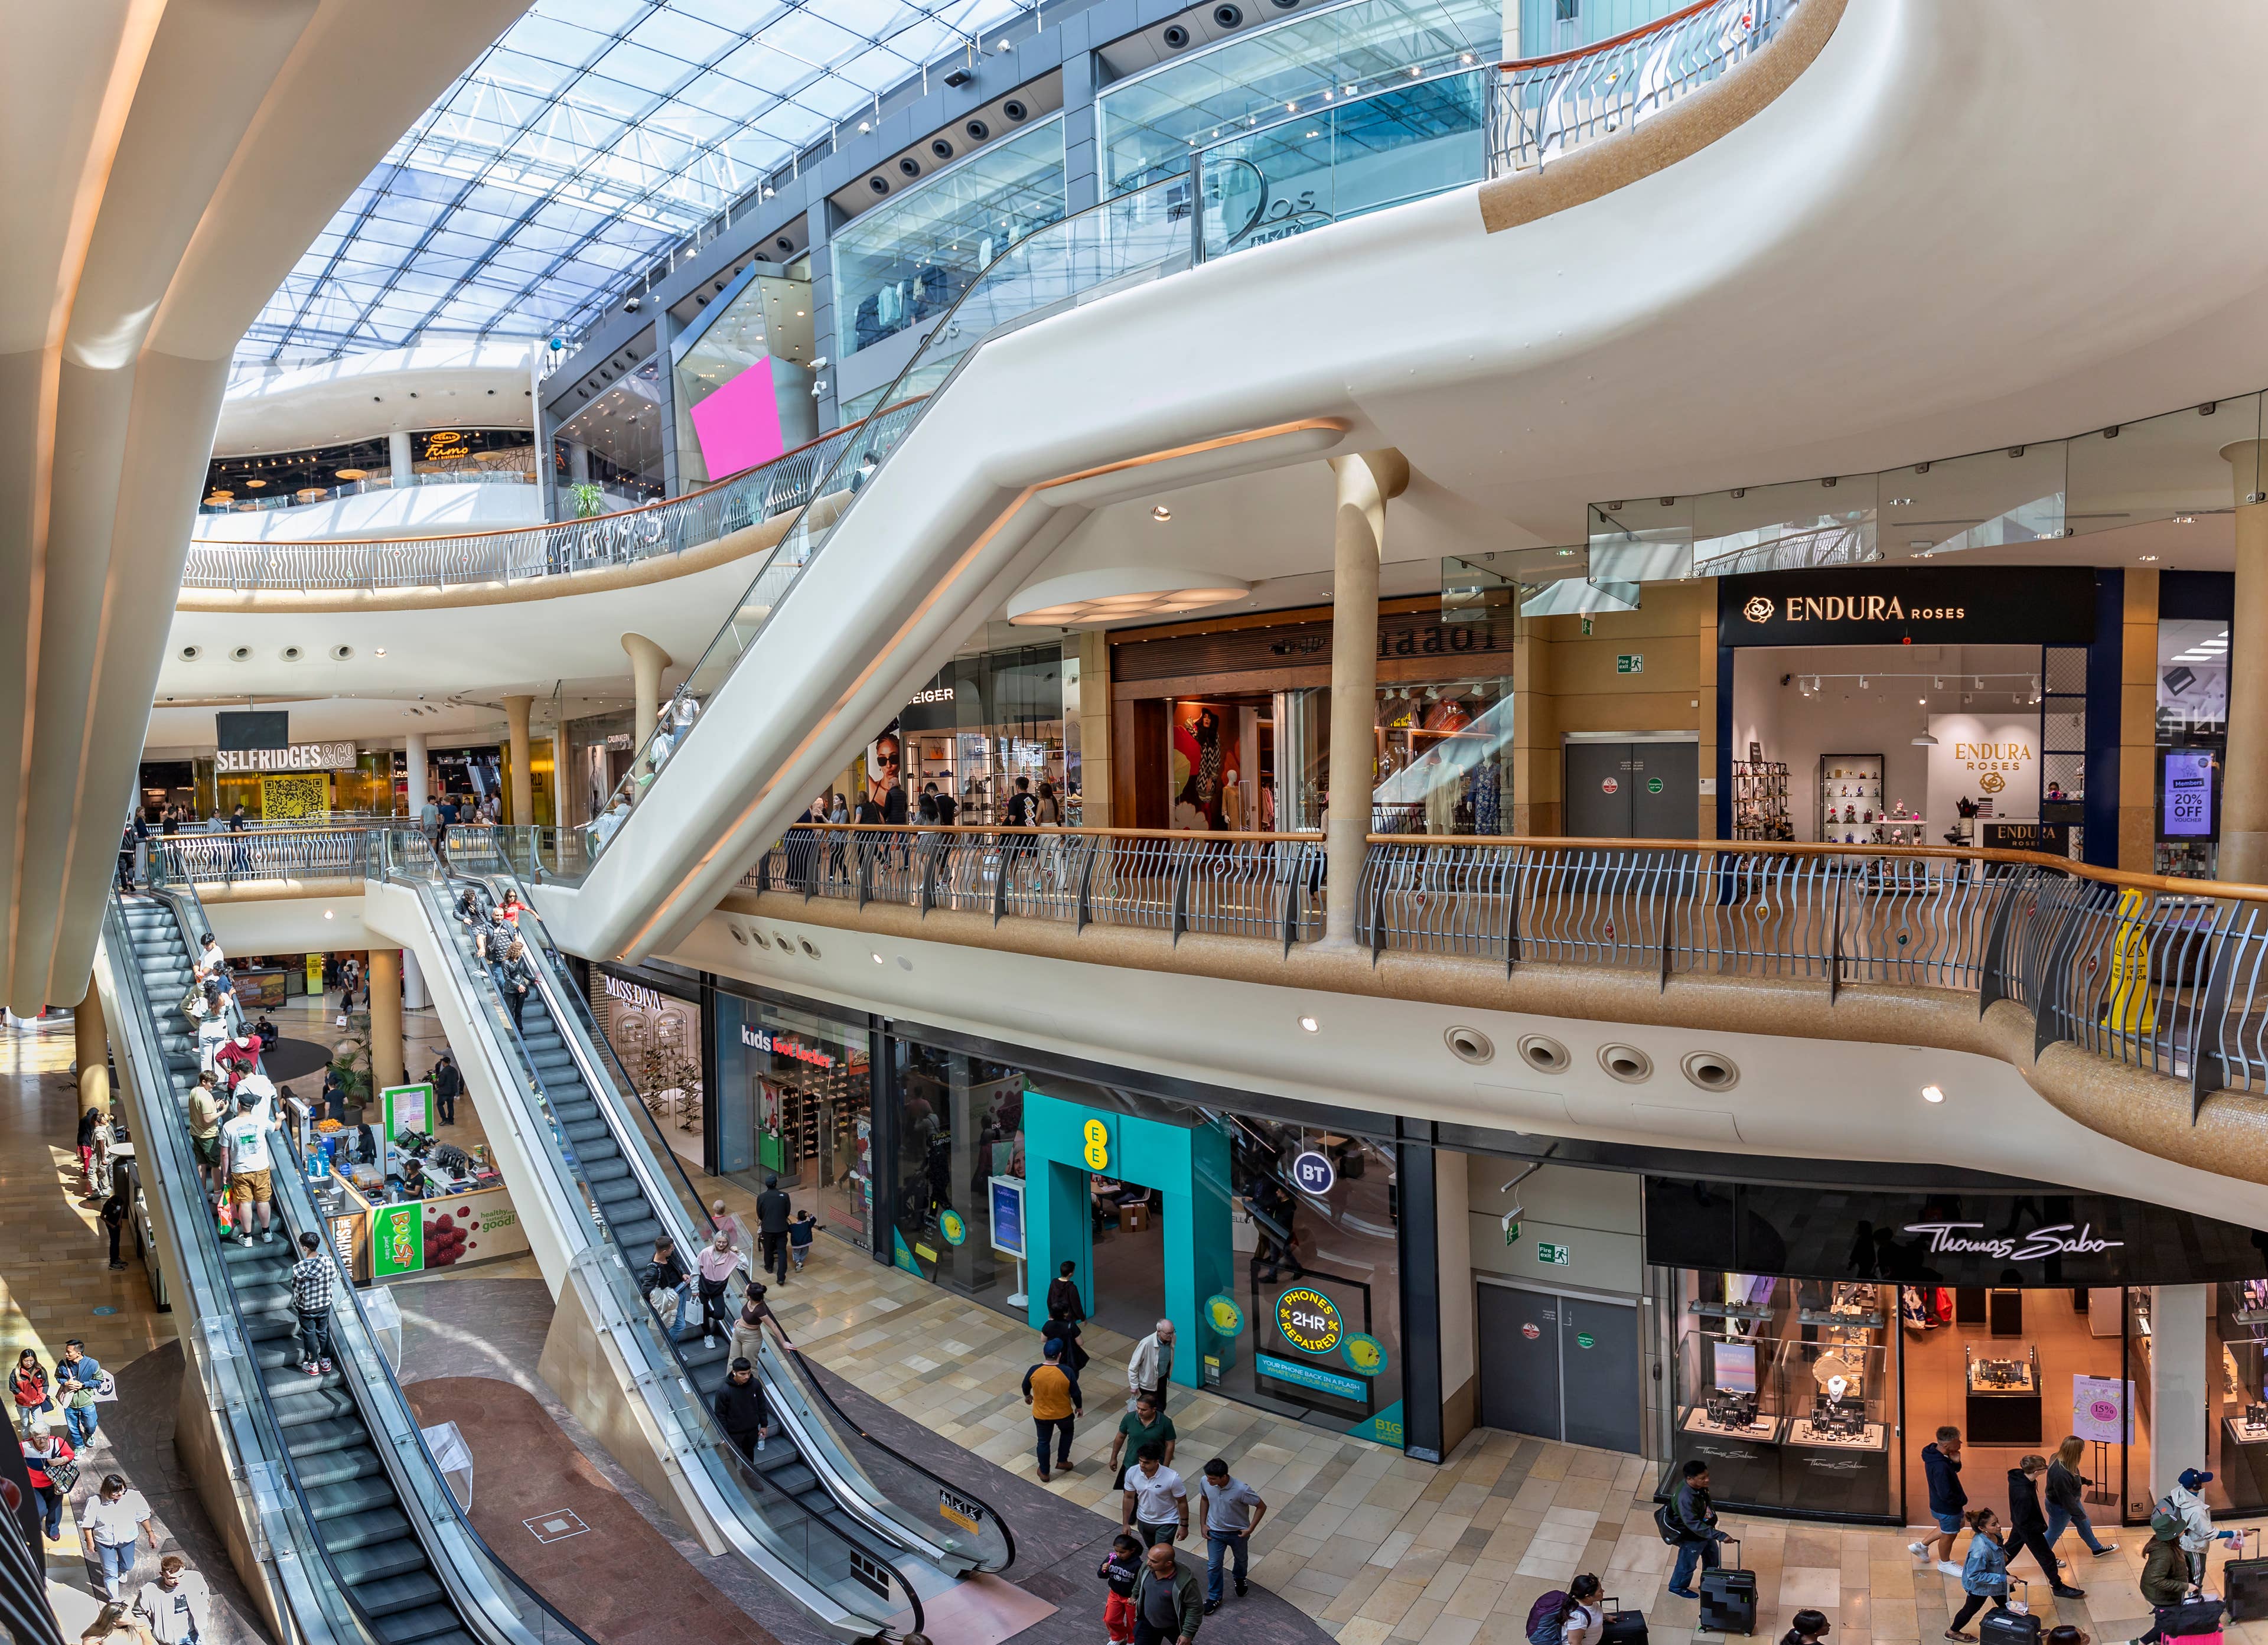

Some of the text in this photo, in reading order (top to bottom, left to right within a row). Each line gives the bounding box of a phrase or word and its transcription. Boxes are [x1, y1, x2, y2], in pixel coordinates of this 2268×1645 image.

[425, 444, 469, 458] Fumo
[1787, 595, 1964, 621] ENDURA ROSES
[908, 688, 954, 704] EIGER
[1955, 743, 2032, 761] ENDURA
[1967, 762, 2019, 770] ROSES
[531, 773, 543, 786] RLD
[2175, 794, 2202, 804] 20%
[2175, 806, 2202, 817] OFF
[1997, 826, 2055, 839] ENDURA
[605, 975, 662, 1011] MISS DIVA
[742, 1025, 830, 1068] kids Foot Locker
[932, 1137, 951, 1146] TURNIN
[1303, 1164, 1325, 1183] BT
[481, 1209, 507, 1219] healthy
[336, 1219, 351, 1229] THE
[483, 1214, 515, 1233] good!
[336, 1229, 353, 1265] SHAKE
[390, 1211, 414, 1268] BOOST
[1904, 1223, 2124, 1260] Thomas Sabo
[1284, 1291, 1333, 1315] PHONES
[1292, 1311, 1325, 1331] 2HR
[1282, 1322, 1336, 1350] REPAIRED
[1262, 1359, 1280, 1369] YOUR
[1281, 1364, 1304, 1376] PHONE
[1305, 1372, 1322, 1381] BACK
[1338, 1380, 1360, 1390] FLASH
[1267, 1366, 1355, 1395] WHATEVER YOUR NETWORK
[2095, 1405, 2114, 1414] 15%
[1376, 1418, 1402, 1434] BIG
[1695, 1446, 1758, 1459] Thomas Sabo
[1803, 1458, 1868, 1470] Thomas Sabo
[1109, 1565, 1135, 1579] OSTON
